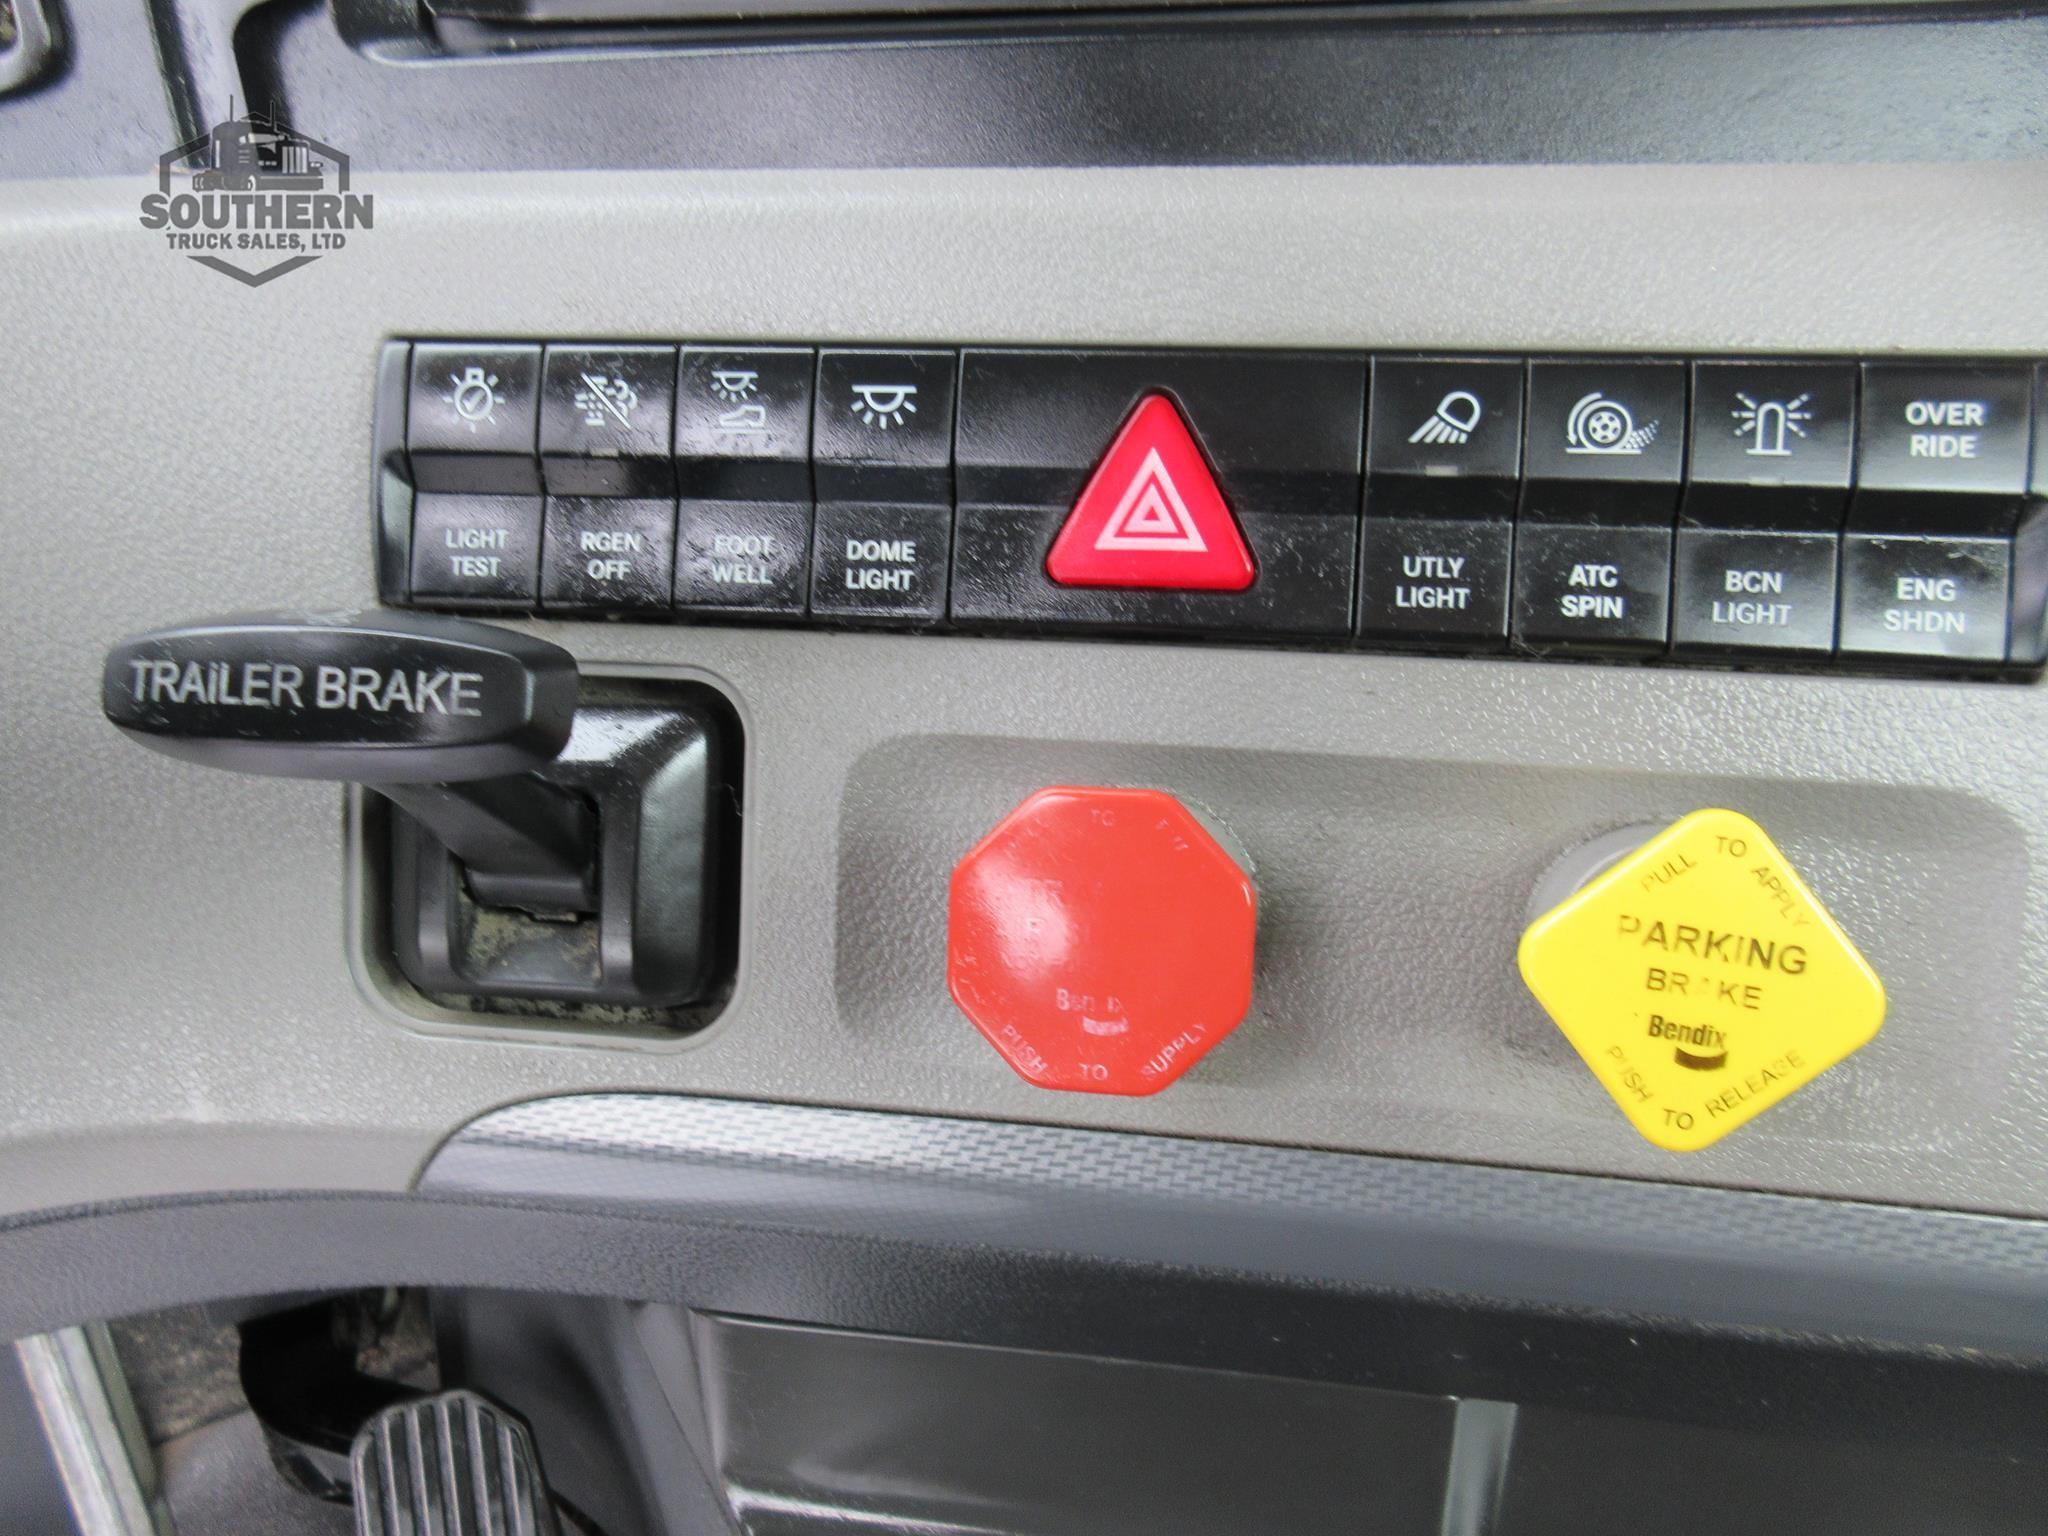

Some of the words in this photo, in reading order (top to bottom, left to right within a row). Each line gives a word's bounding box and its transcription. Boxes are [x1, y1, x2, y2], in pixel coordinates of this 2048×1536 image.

[1904, 401, 1983, 427] OVER
[1910, 434, 1975, 459] RIDE
[445, 529, 508, 550] LIGHT
[580, 531, 640, 553] RGEN
[714, 534, 773, 555] FOOT
[846, 540, 916, 563] DOME
[451, 556, 501, 577] TEST
[587, 560, 630, 581] OFF
[712, 563, 773, 585] WELL
[1403, 556, 1466, 579] UTLY
[1567, 563, 1619, 588] ATC
[845, 569, 915, 592] LIGHT
[1725, 569, 1783, 593] BCN
[1896, 577, 1956, 601] ENG
[1396, 585, 1470, 609] LIGHT
[1561, 594, 1623, 620] SPIN
[1712, 602, 1792, 627] LIGHT
[1884, 608, 1966, 635] SHDN
[317, 666, 483, 717] BRAKE
[1716, 835, 1748, 858] TO
[1752, 866, 1810, 929] APPLY
[1618, 914, 1809, 976] PARKING
[1646, 967, 1762, 1011] BRKE
[1648, 1014, 1727, 1049] Bendix
[1662, 1108, 1694, 1131] TO
